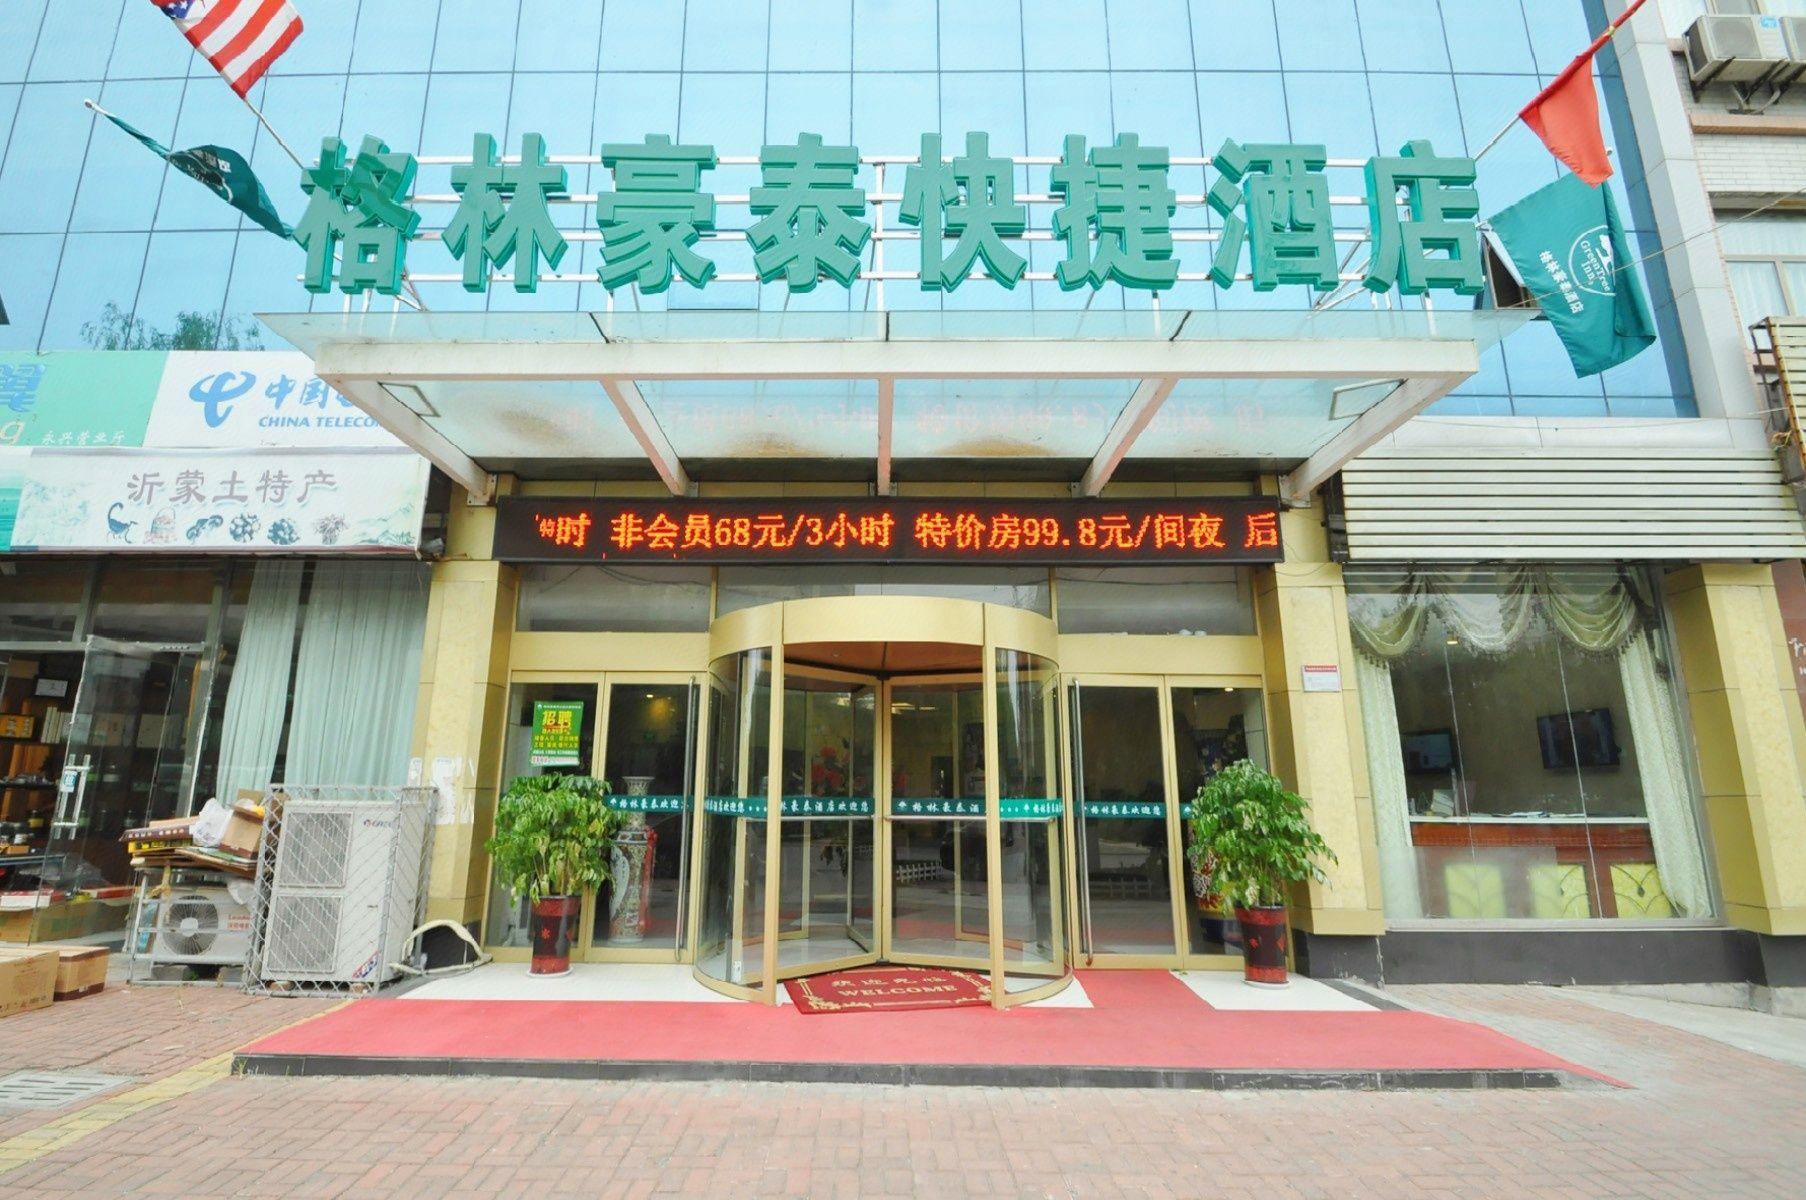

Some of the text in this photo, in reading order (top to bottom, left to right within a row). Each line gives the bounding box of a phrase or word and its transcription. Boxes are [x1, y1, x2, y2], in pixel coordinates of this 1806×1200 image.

[292, 131, 1485, 296] 格林豪泰快捷酒店
[1580, 240, 1611, 292] GreenTree
[1581, 261, 1595, 284] Inn
[258, 416, 310, 428] CHINA
[127, 469, 338, 505] 沂蒙土特产
[610, 512, 895, 549] 非会员68元/3小时
[914, 512, 1226, 549] 特价房99.8元/间夜
[1244, 512, 1278, 547] 后
[838, 984, 958, 997] WELCOME
